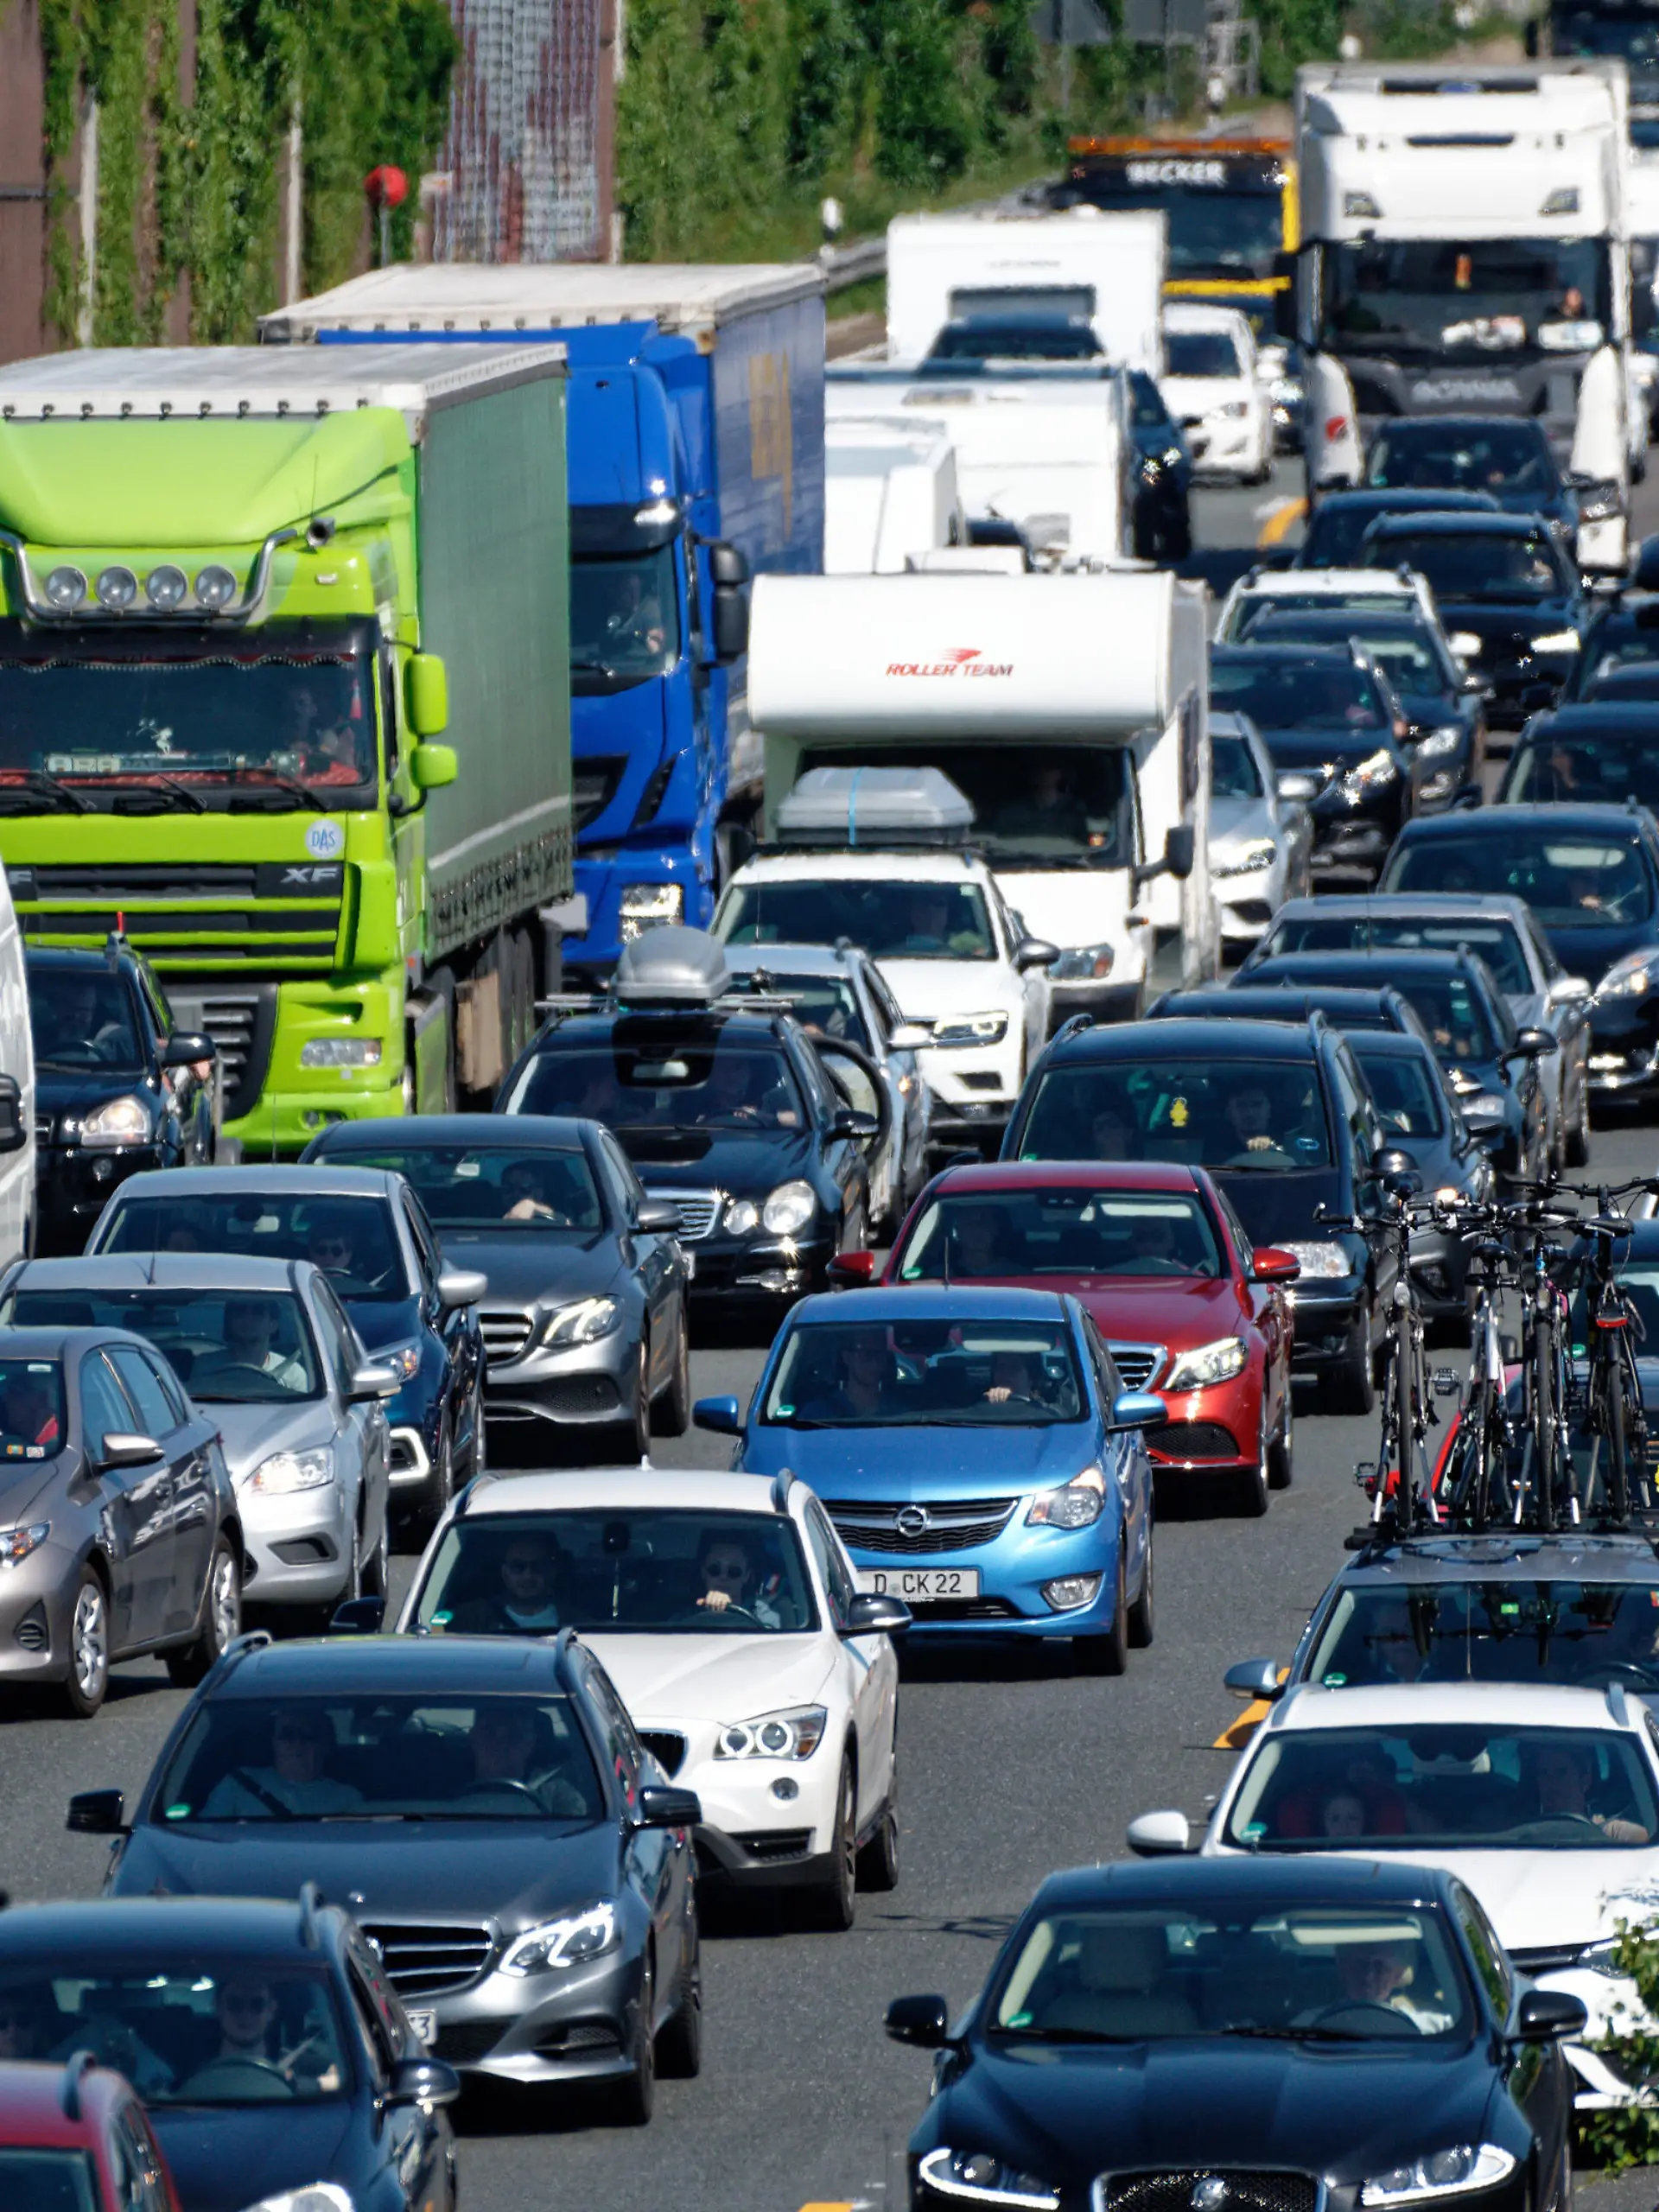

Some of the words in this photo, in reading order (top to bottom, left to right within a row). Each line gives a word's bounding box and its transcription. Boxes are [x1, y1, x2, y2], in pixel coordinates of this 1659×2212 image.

[885, 663, 957, 677] ROLLER
[963, 664, 1014, 677] TEAM
[311, 828, 335, 851] DAS
[280, 867, 339, 883] XF
[874, 1573, 887, 1594] D
[902, 1573, 931, 1594] CK
[936, 1573, 962, 1593] 22
